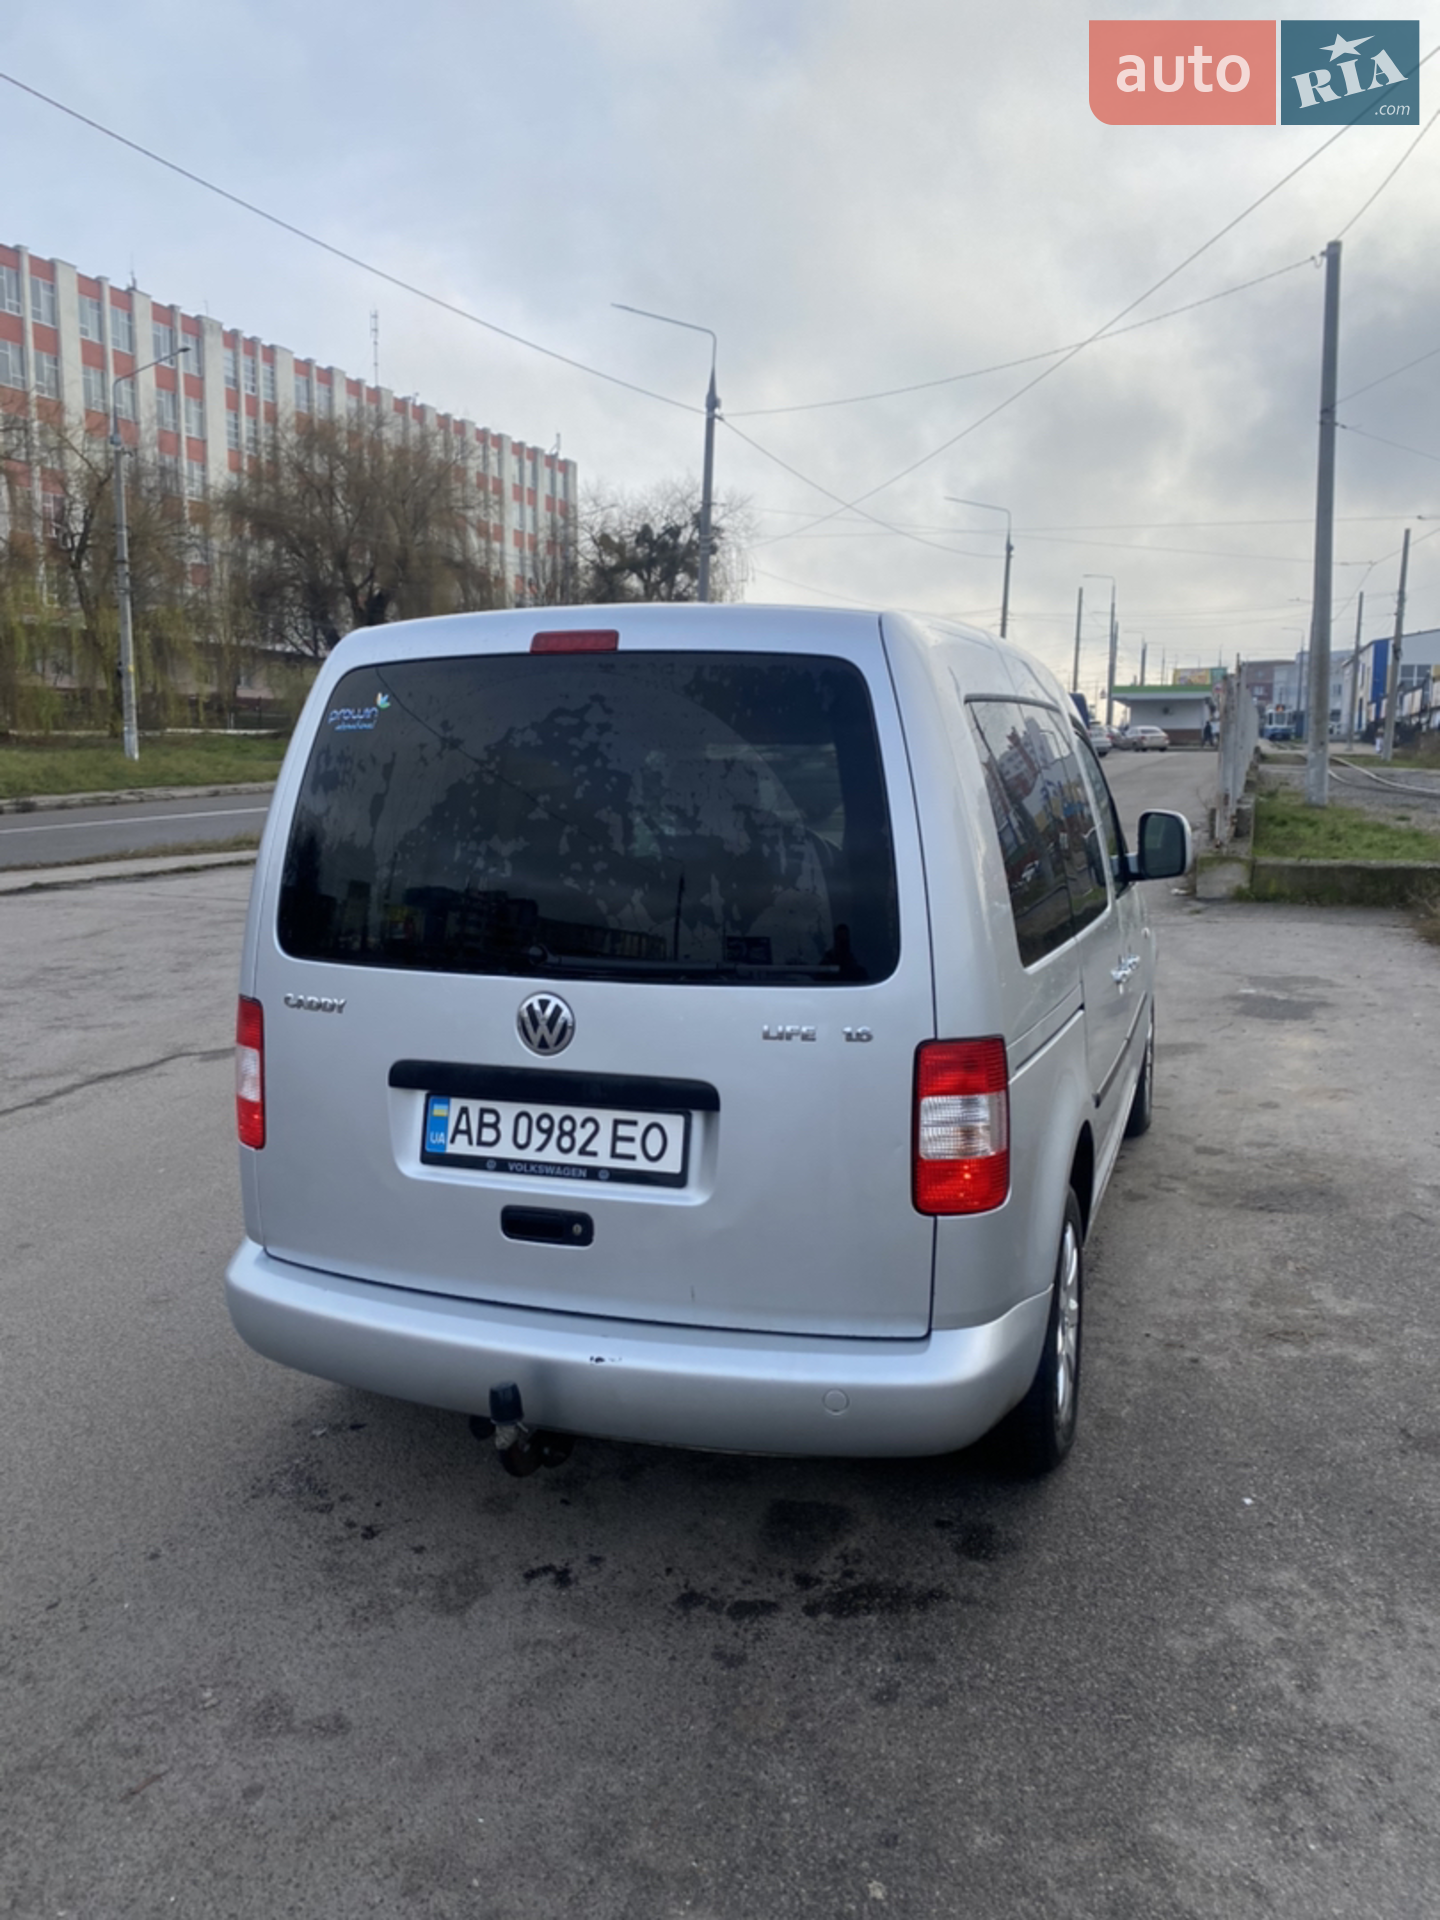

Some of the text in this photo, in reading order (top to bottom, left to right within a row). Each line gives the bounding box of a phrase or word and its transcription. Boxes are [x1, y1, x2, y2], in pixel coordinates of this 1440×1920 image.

[284, 993, 347, 1014] CADDY
[762, 1025, 817, 1041] LIFE
[429, 1131, 446, 1145] UA
[450, 1106, 667, 1162] AB 0982 EO
[508, 1161, 588, 1178] VOLKSWAGEN
